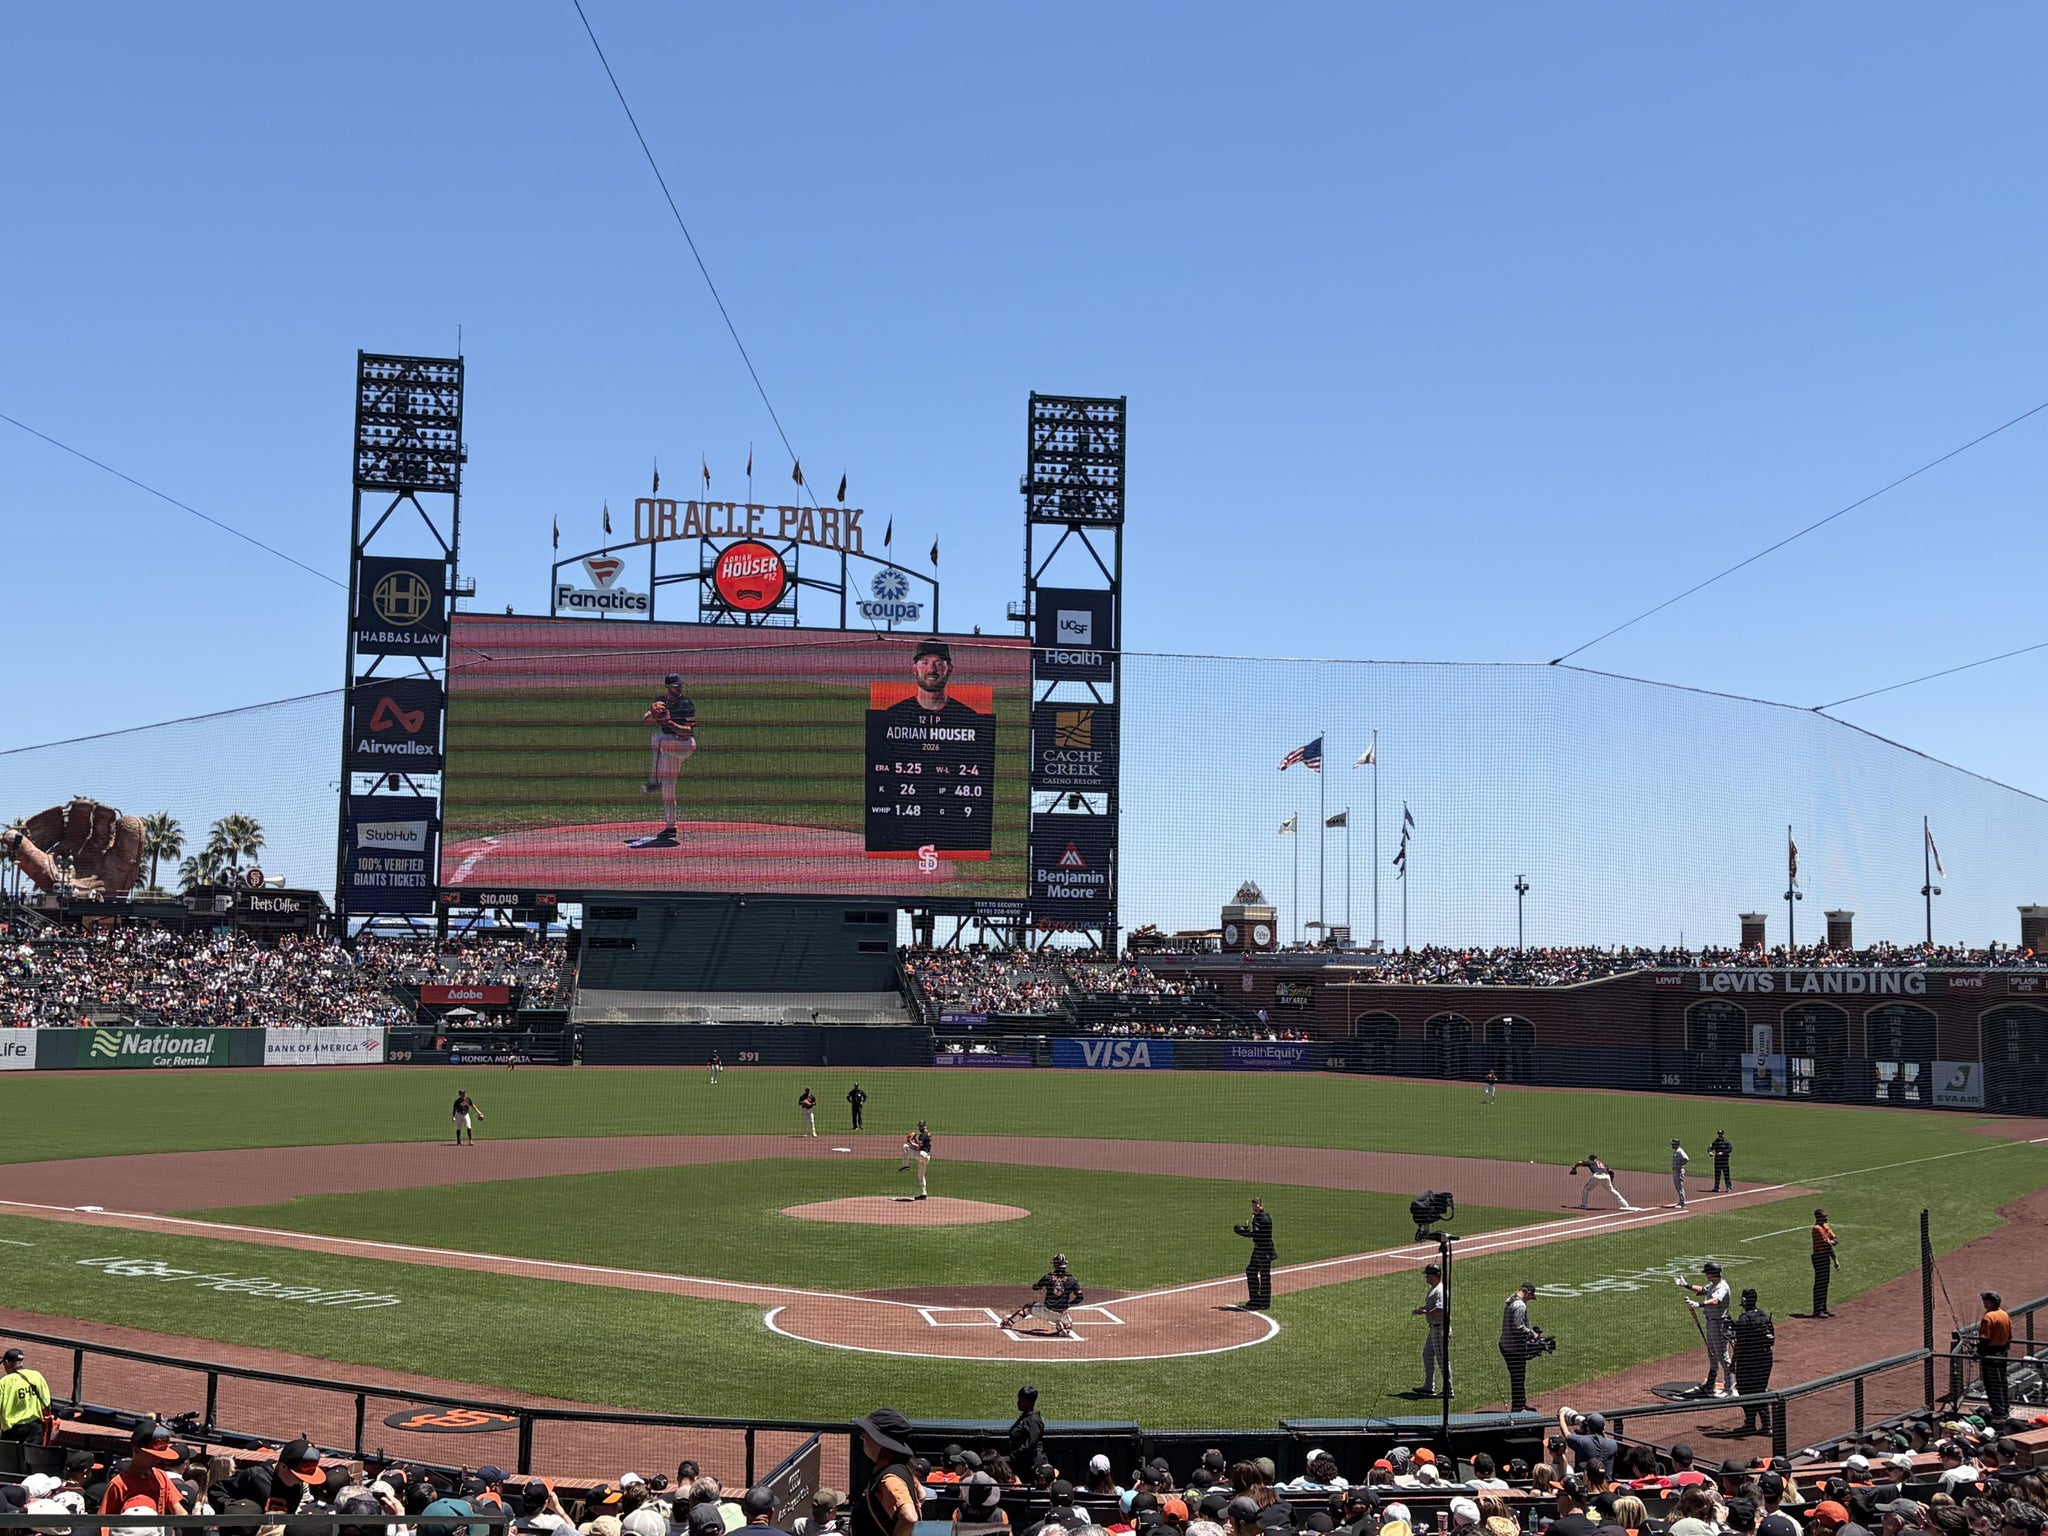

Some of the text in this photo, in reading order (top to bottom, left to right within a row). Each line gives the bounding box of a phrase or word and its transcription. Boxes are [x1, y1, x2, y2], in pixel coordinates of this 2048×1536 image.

[634, 498, 864, 554] ORACLE PARK
[725, 553, 752, 565] ADRIAN
[722, 557, 778, 578] HOUSER
[763, 572, 777, 580] #12
[558, 588, 648, 611] Fanatics
[862, 600, 917, 620] coupa
[1060, 619, 1088, 634] UCSF
[360, 631, 440, 644] HABBAS LAW
[1045, 649, 1102, 665] Health
[887, 726, 976, 742] ADRIAN HOUSER
[357, 740, 434, 756] Airwallex
[922, 743, 940, 751] 2026
[1043, 750, 1102, 764] CACHE
[875, 764, 890, 772] ERA
[895, 762, 922, 774] 5.25
[959, 764, 979, 776] 2-4
[1045, 763, 1098, 776] CREEK
[1042, 777, 1102, 785] CASINO RESORT
[879, 785, 885, 793] K
[900, 784, 916, 795] 26
[954, 786, 982, 797] 48.0
[872, 806, 891, 814] WHIP
[895, 804, 921, 816] 1.48
[964, 807, 972, 818] 9
[366, 829, 418, 842] StubHub
[358, 857, 424, 871] 100% VERIFIED
[354, 873, 426, 887] GIANTS TICKETS
[1037, 870, 1104, 885] Benjamin
[1047, 884, 1094, 898] Moore
[273, 898, 299, 913] Coffee
[480, 893, 518, 905] $10,049
[1785, 972, 1926, 994] LANDING
[448, 989, 483, 999] Adobe
[122, 1034, 214, 1055] National
[268, 1044, 359, 1053] BANK OF AMERICA
[153, 1056, 209, 1065] Car Rental
[389, 1052, 411, 1061] 399
[461, 1055, 530, 1063] KONICA MINLTA
[739, 1052, 759, 1061] 391
[1076, 1041, 1150, 1067] VISA
[1232, 1047, 1302, 1060] HealthEquity
[1326, 1058, 1345, 1067] 415
[1661, 1074, 1680, 1084] 365
[160, 1267, 402, 1309] Health
